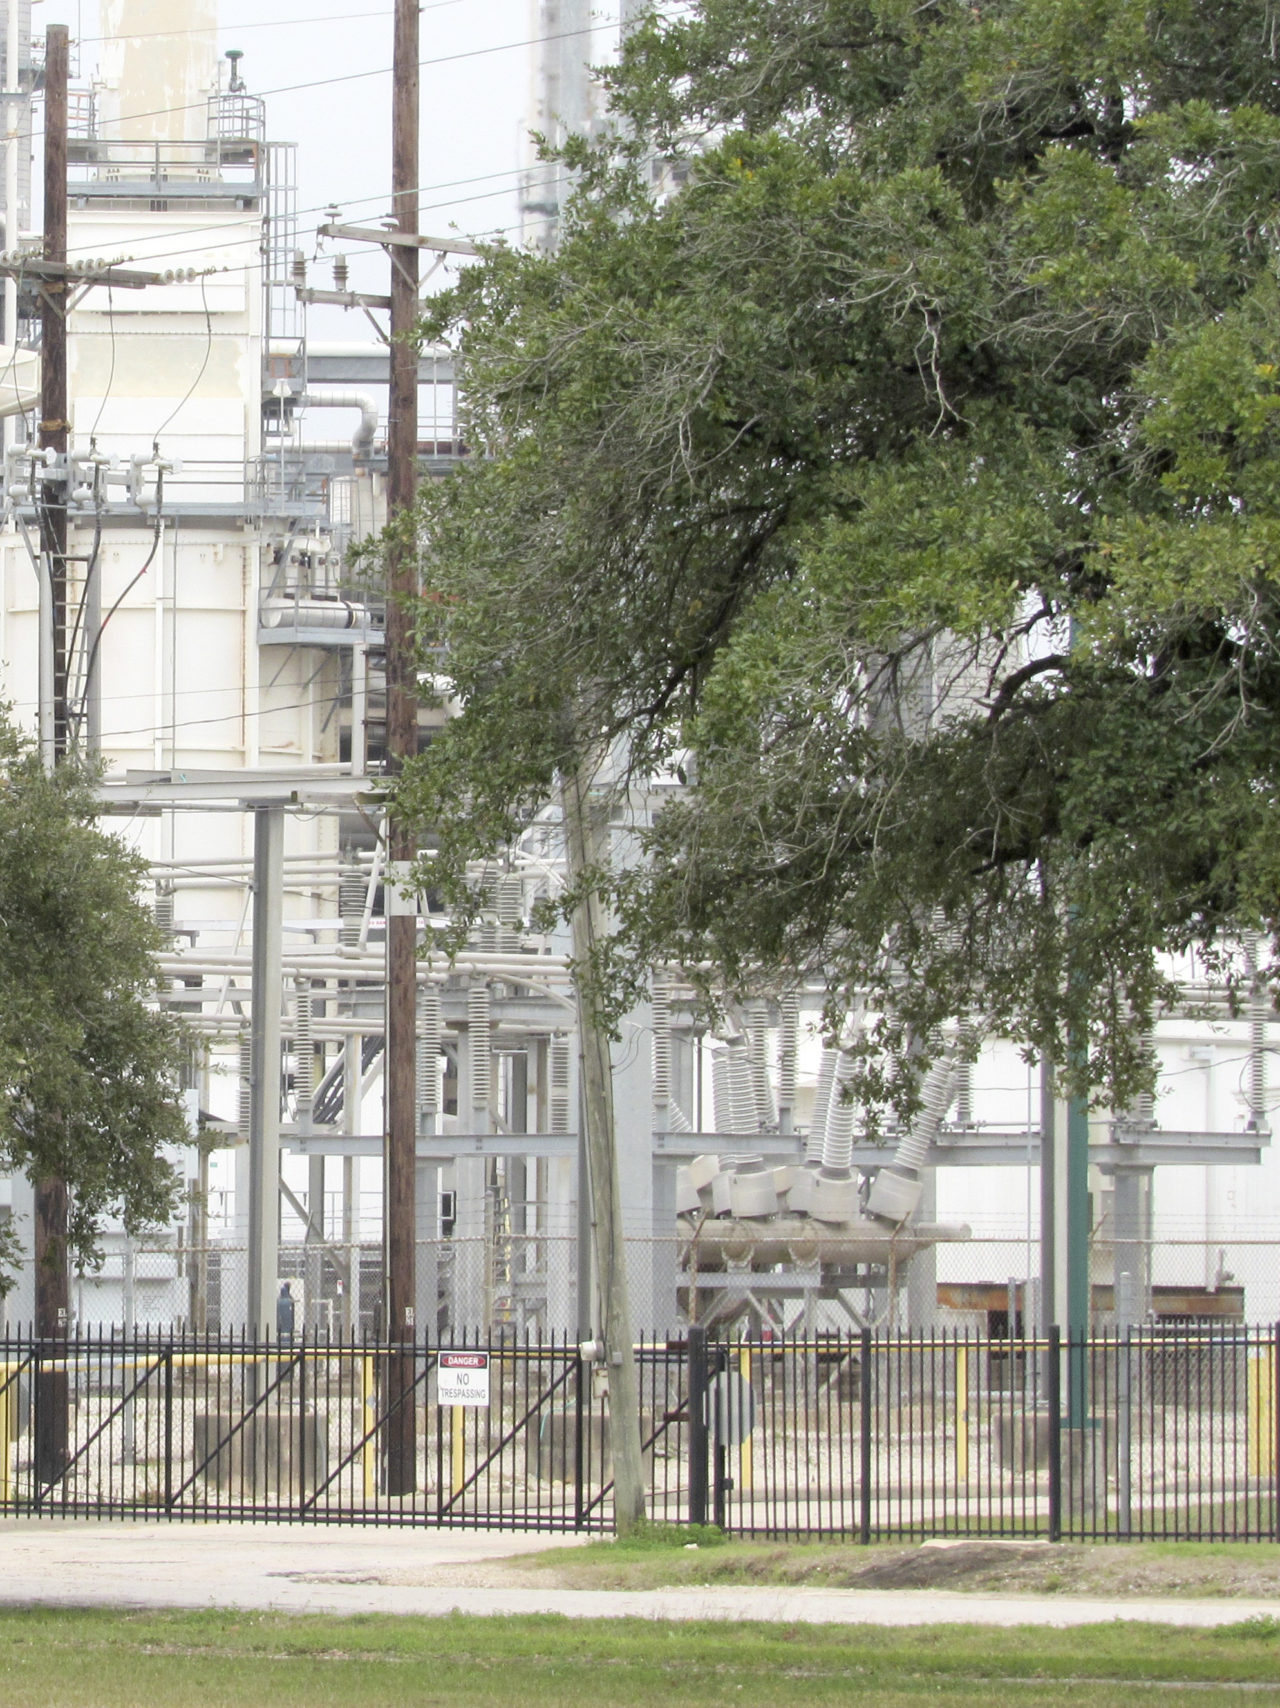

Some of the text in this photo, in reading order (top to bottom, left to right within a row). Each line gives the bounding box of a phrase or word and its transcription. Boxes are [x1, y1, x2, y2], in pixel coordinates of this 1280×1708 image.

[447, 1356, 479, 1366] DANGER
[456, 1373, 470, 1386] NO
[441, 1388, 486, 1399] TRESPASSING
